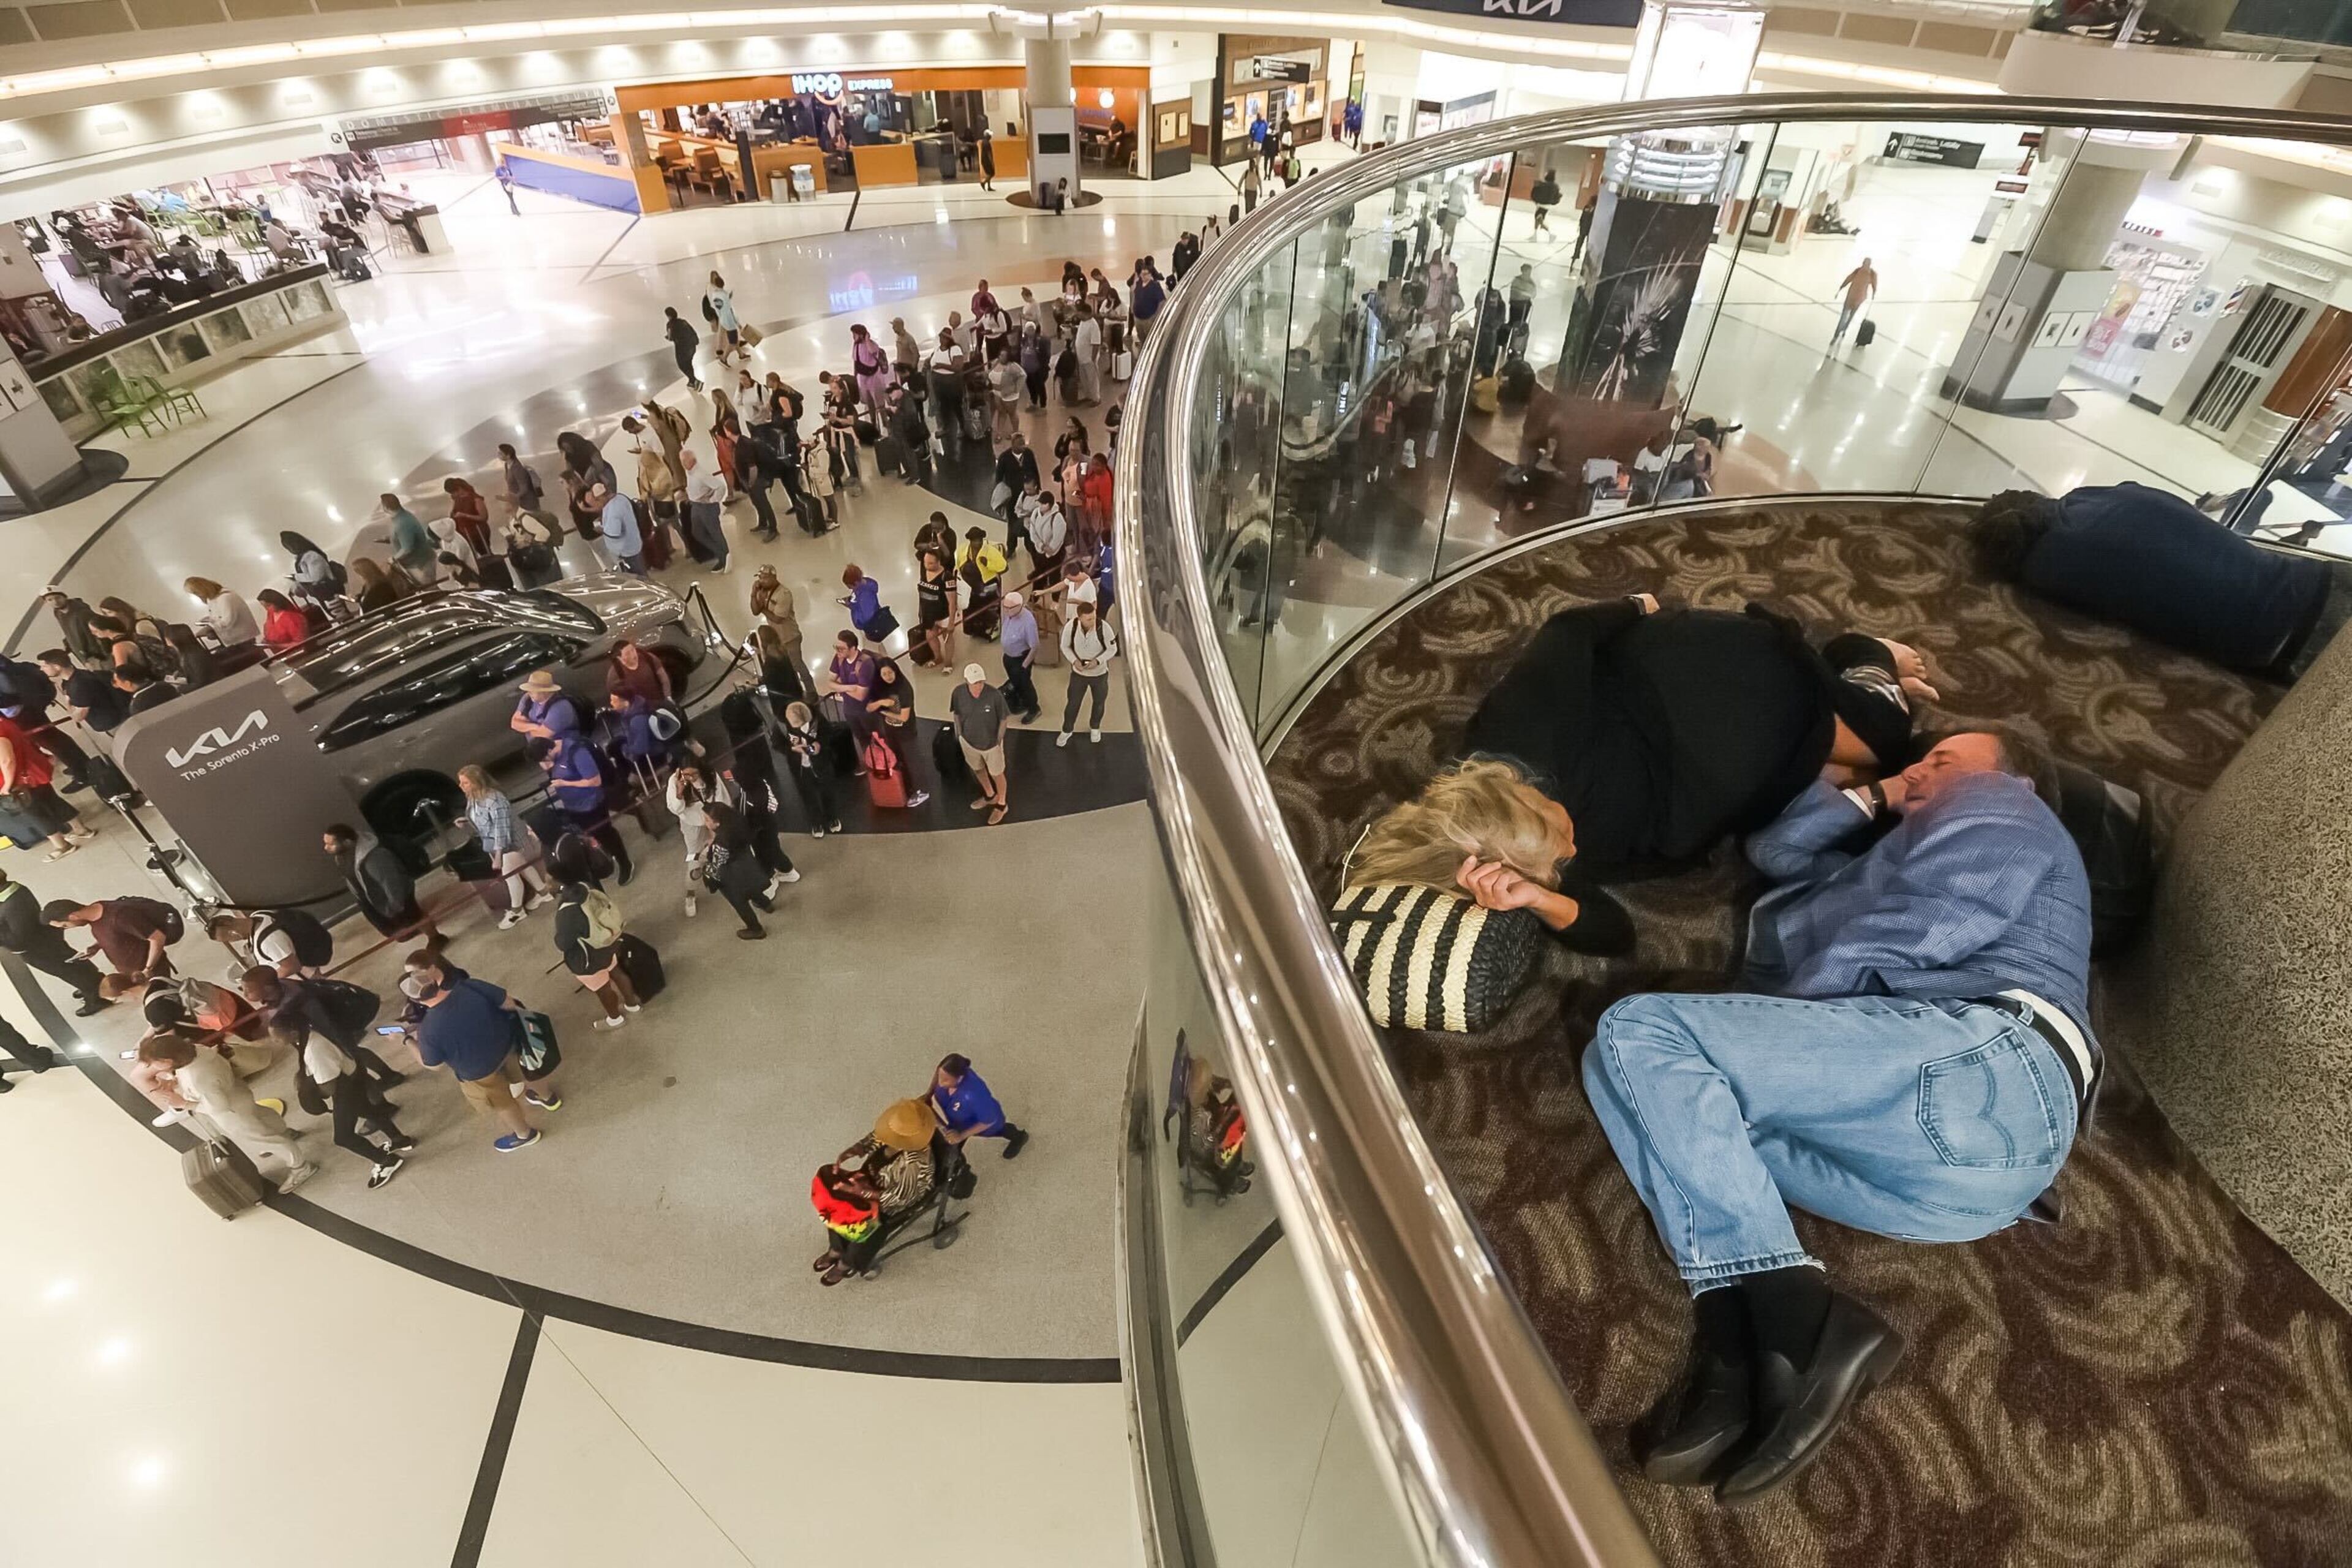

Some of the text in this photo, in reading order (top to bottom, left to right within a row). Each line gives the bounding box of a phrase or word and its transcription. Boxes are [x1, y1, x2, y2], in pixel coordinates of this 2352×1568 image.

[792, 73, 843, 98] IHOP
[165, 709, 268, 767] KIA
[180, 734, 280, 781] The Sorento X-Pro
